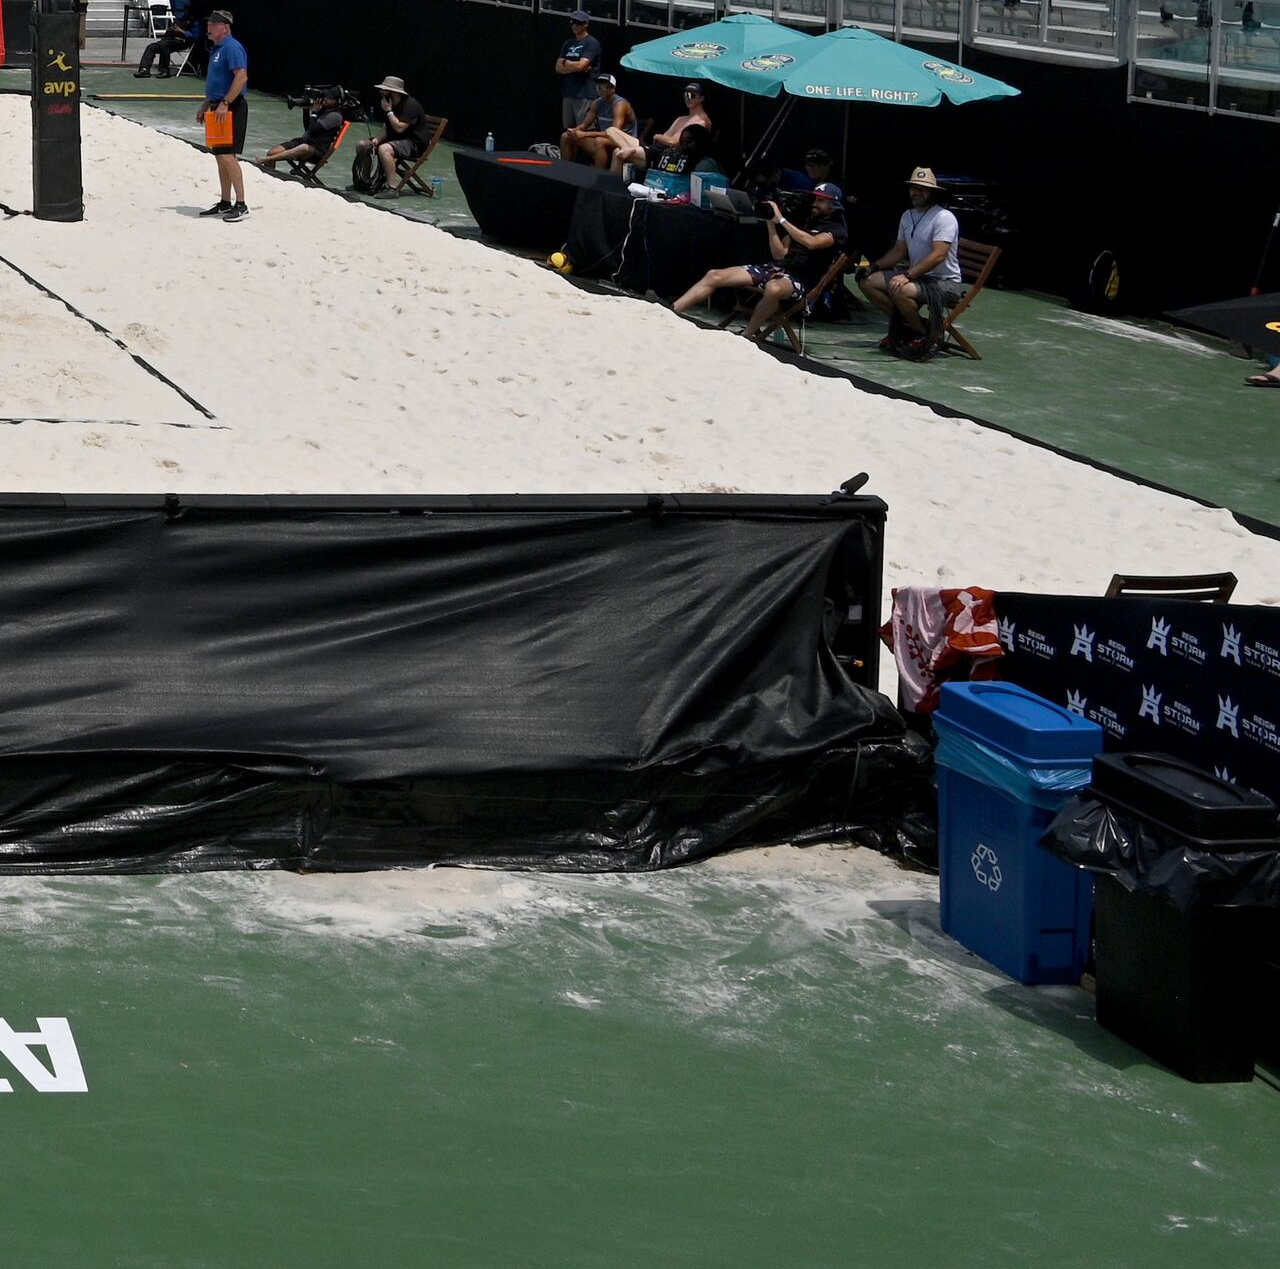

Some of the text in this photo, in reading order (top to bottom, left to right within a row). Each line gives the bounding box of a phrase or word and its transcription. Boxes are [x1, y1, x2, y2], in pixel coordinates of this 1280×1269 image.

[43, 81, 76, 97] avp
[805, 84, 919, 102] ONE LIFE. RIGHT?
[1018, 633, 1054, 656] STORM
[1097, 643, 1134, 668] STORM
[1171, 636, 1206, 661] STORM
[1089, 709, 1125, 736] STORM
[1164, 705, 1200, 731] STORM
